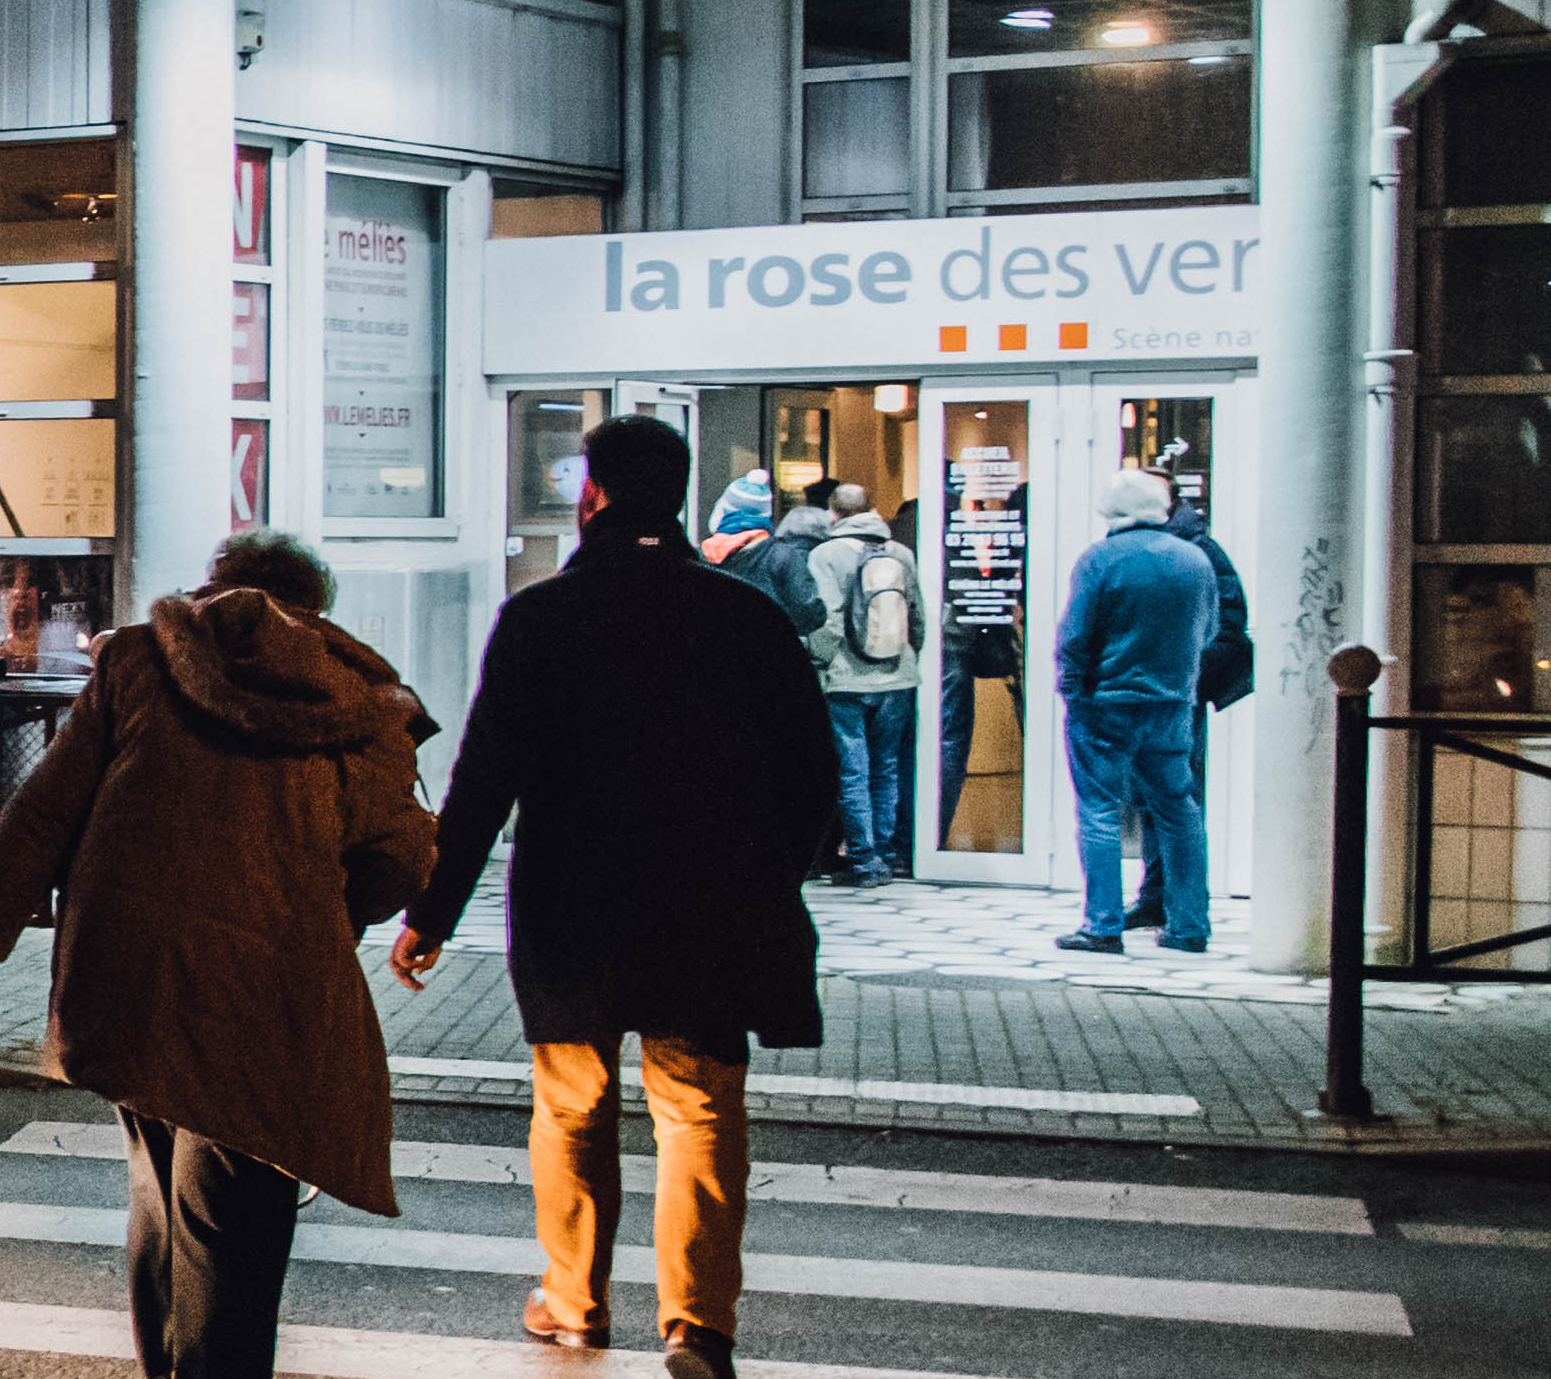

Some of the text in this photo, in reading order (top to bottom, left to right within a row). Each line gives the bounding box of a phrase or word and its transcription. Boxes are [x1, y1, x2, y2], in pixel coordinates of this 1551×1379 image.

[604, 240, 680, 312] la
[707, 250, 913, 308] rose
[940, 225, 1090, 302] des
[1112, 326, 1203, 350] Scène
